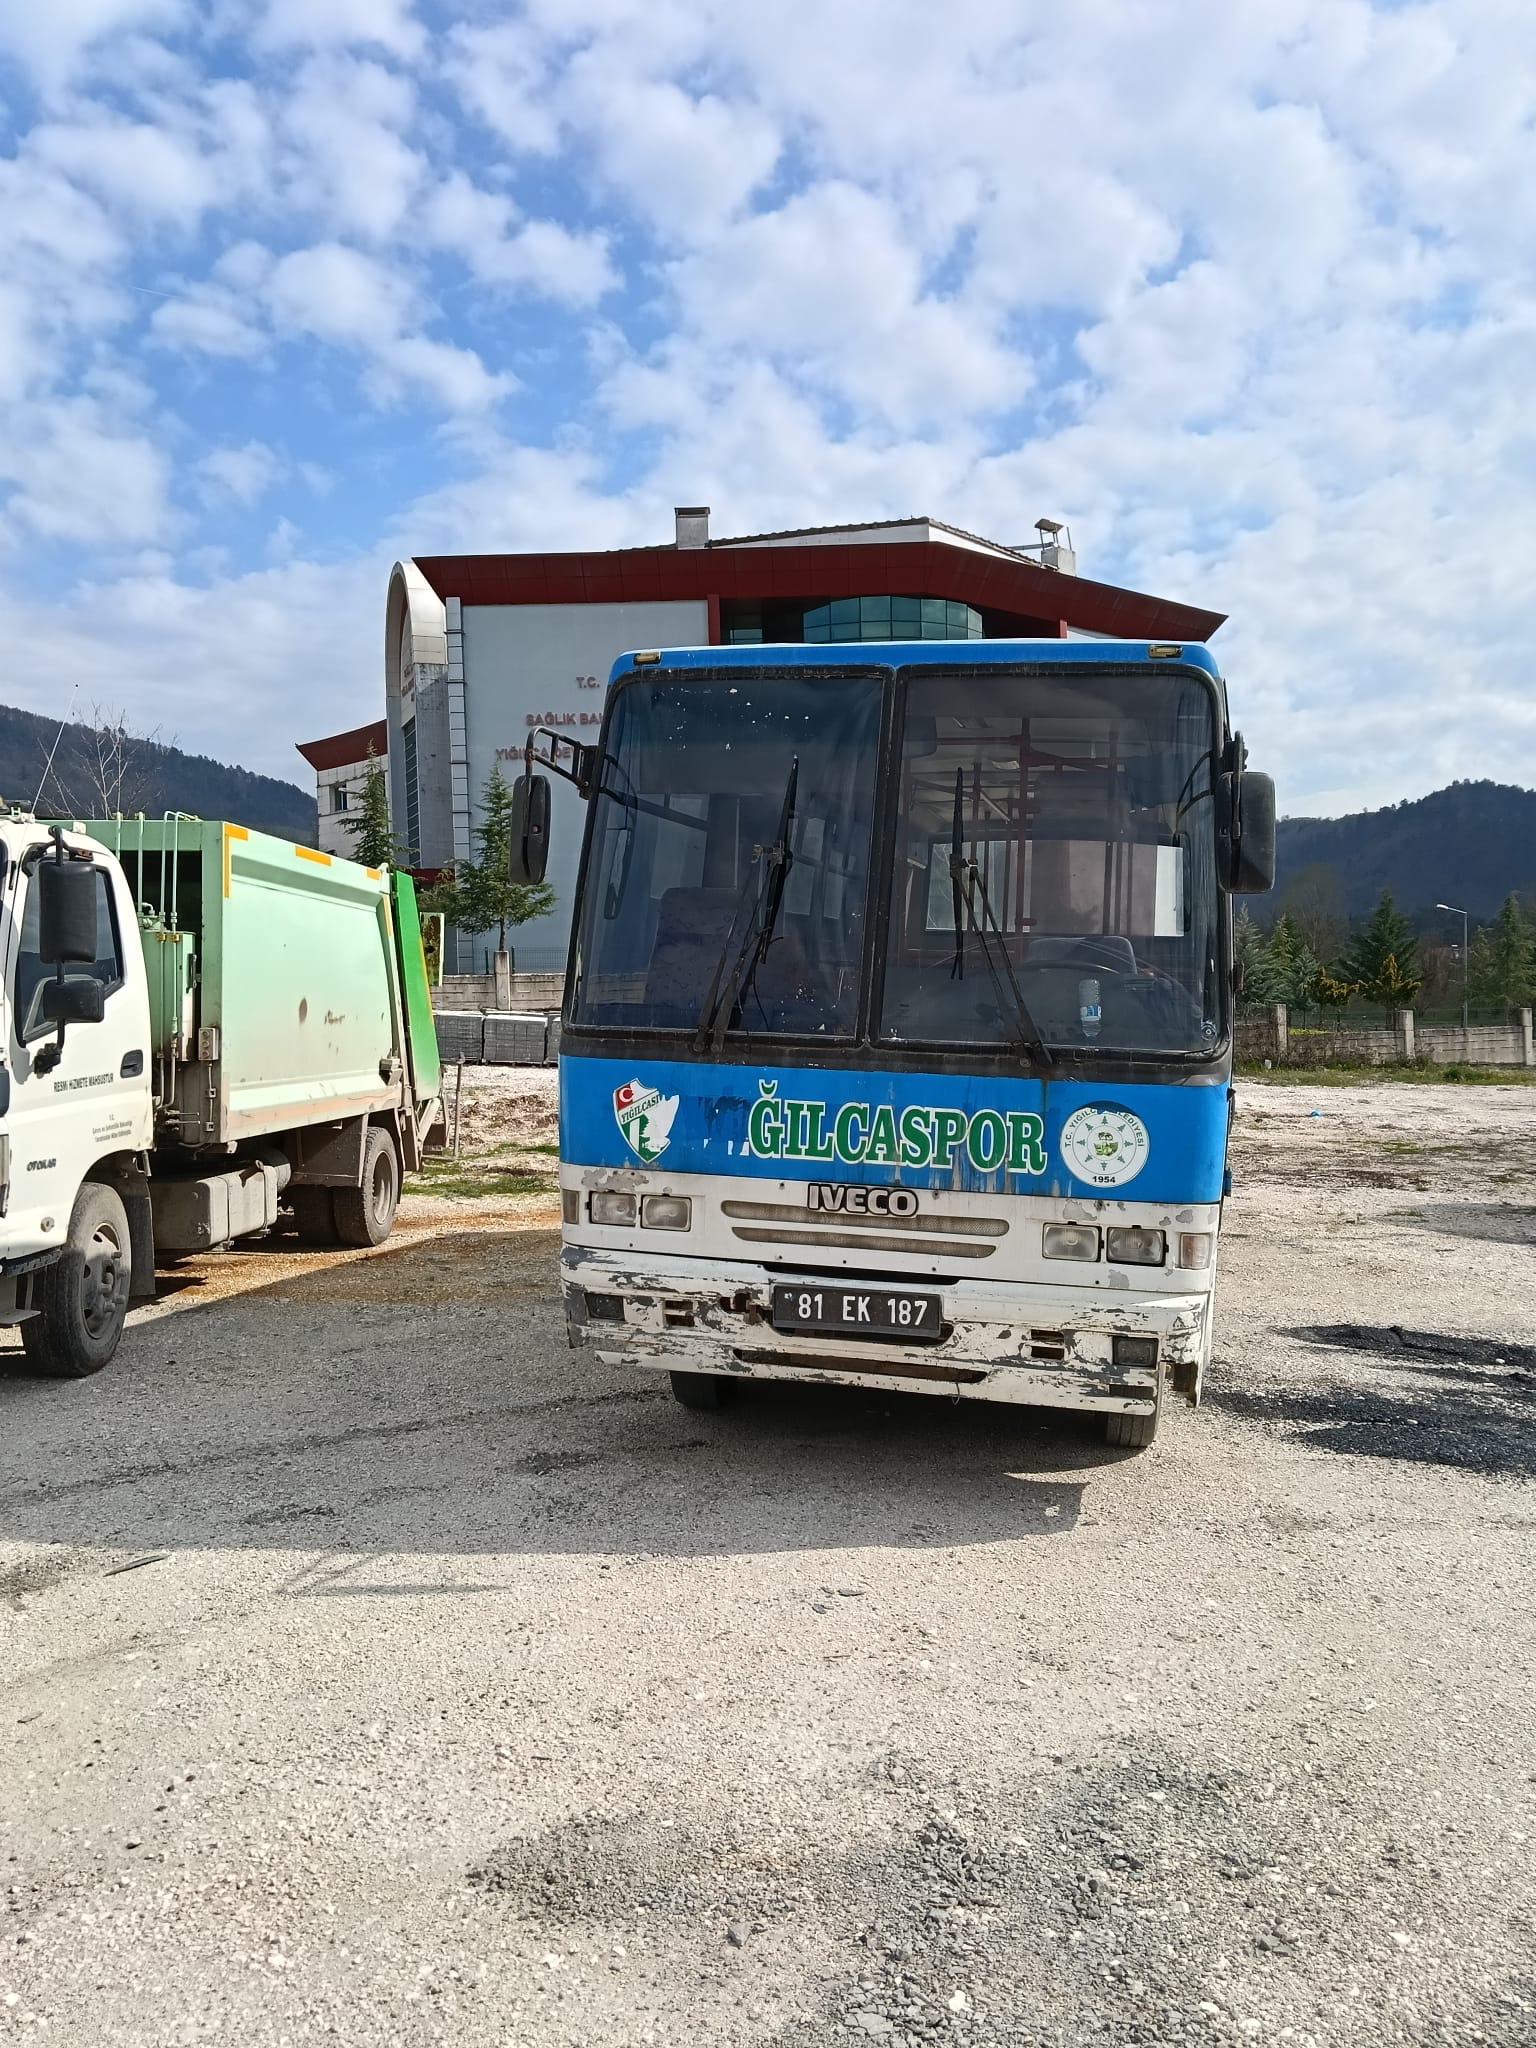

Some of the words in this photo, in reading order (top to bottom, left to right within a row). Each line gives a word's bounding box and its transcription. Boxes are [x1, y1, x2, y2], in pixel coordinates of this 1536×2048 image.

[576, 676, 600, 688] T.C.
[525, 711, 576, 726] SAĞLIK
[495, 745, 549, 760] YIĞIA
[1069, 1107, 1096, 1129] YIĞILC
[1092, 1175, 1116, 1183] 1954
[806, 1183, 919, 1217] IVECO
[798, 1293, 823, 1320] 81
[842, 1295, 871, 1322] EK
[887, 1298, 928, 1326] 187
